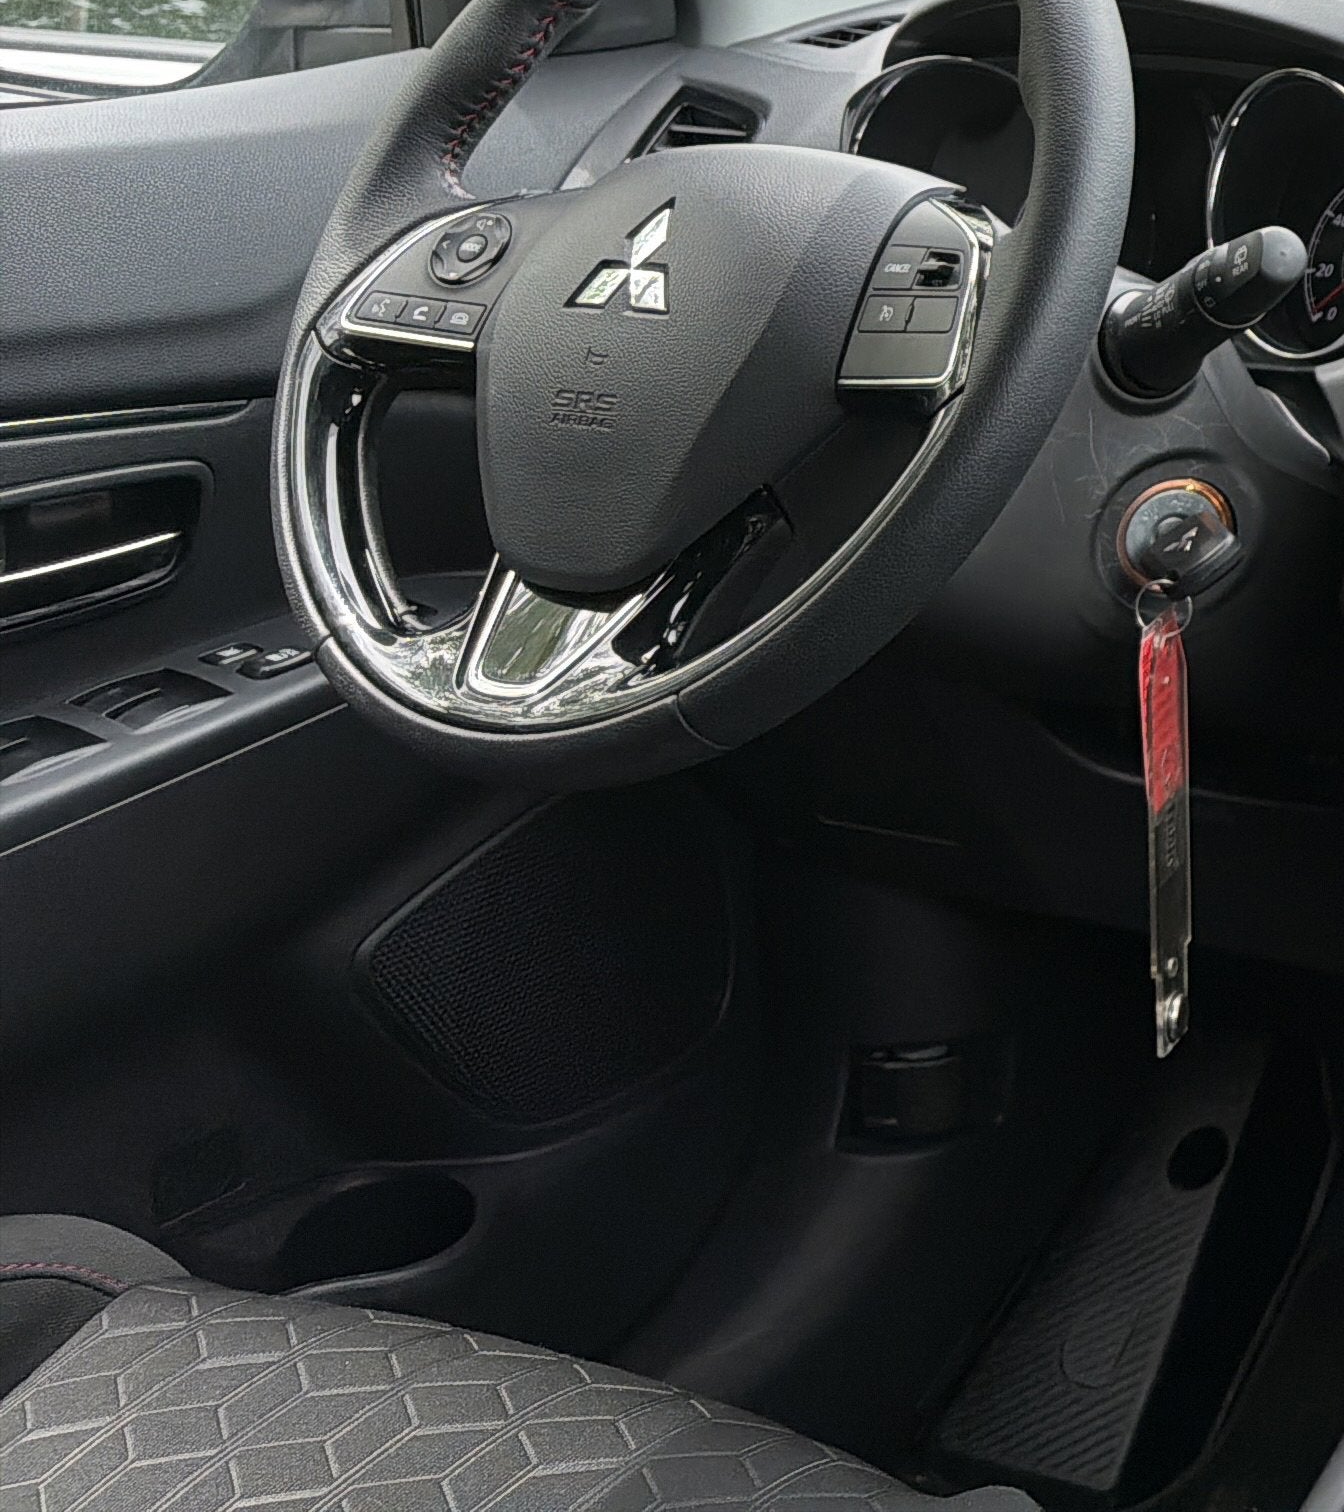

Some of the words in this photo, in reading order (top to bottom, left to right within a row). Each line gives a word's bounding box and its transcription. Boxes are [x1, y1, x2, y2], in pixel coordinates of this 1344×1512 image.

[1315, 263, 1335, 278] 20
[1326, 306, 1338, 321] 0
[551, 389, 618, 412] SRS
